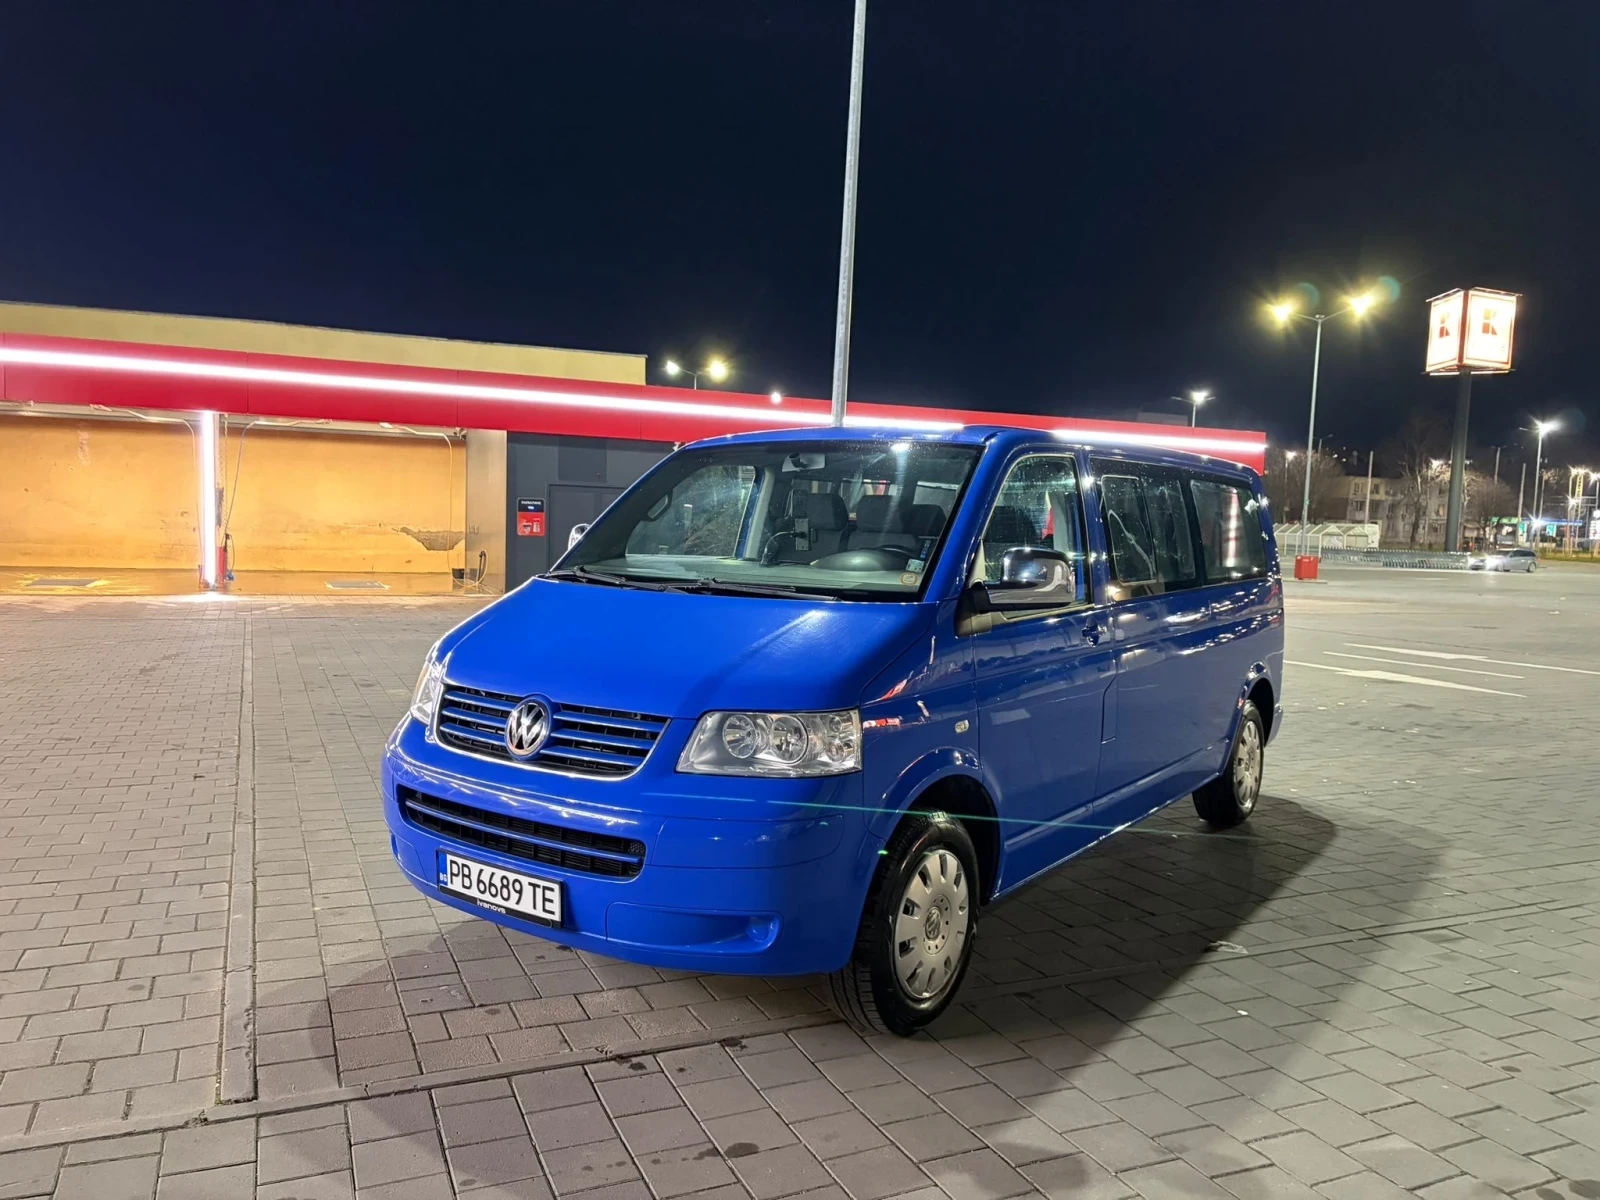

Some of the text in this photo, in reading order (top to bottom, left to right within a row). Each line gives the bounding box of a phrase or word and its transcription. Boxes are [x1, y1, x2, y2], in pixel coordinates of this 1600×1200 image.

[449, 859, 556, 916] PB 6689 TE
